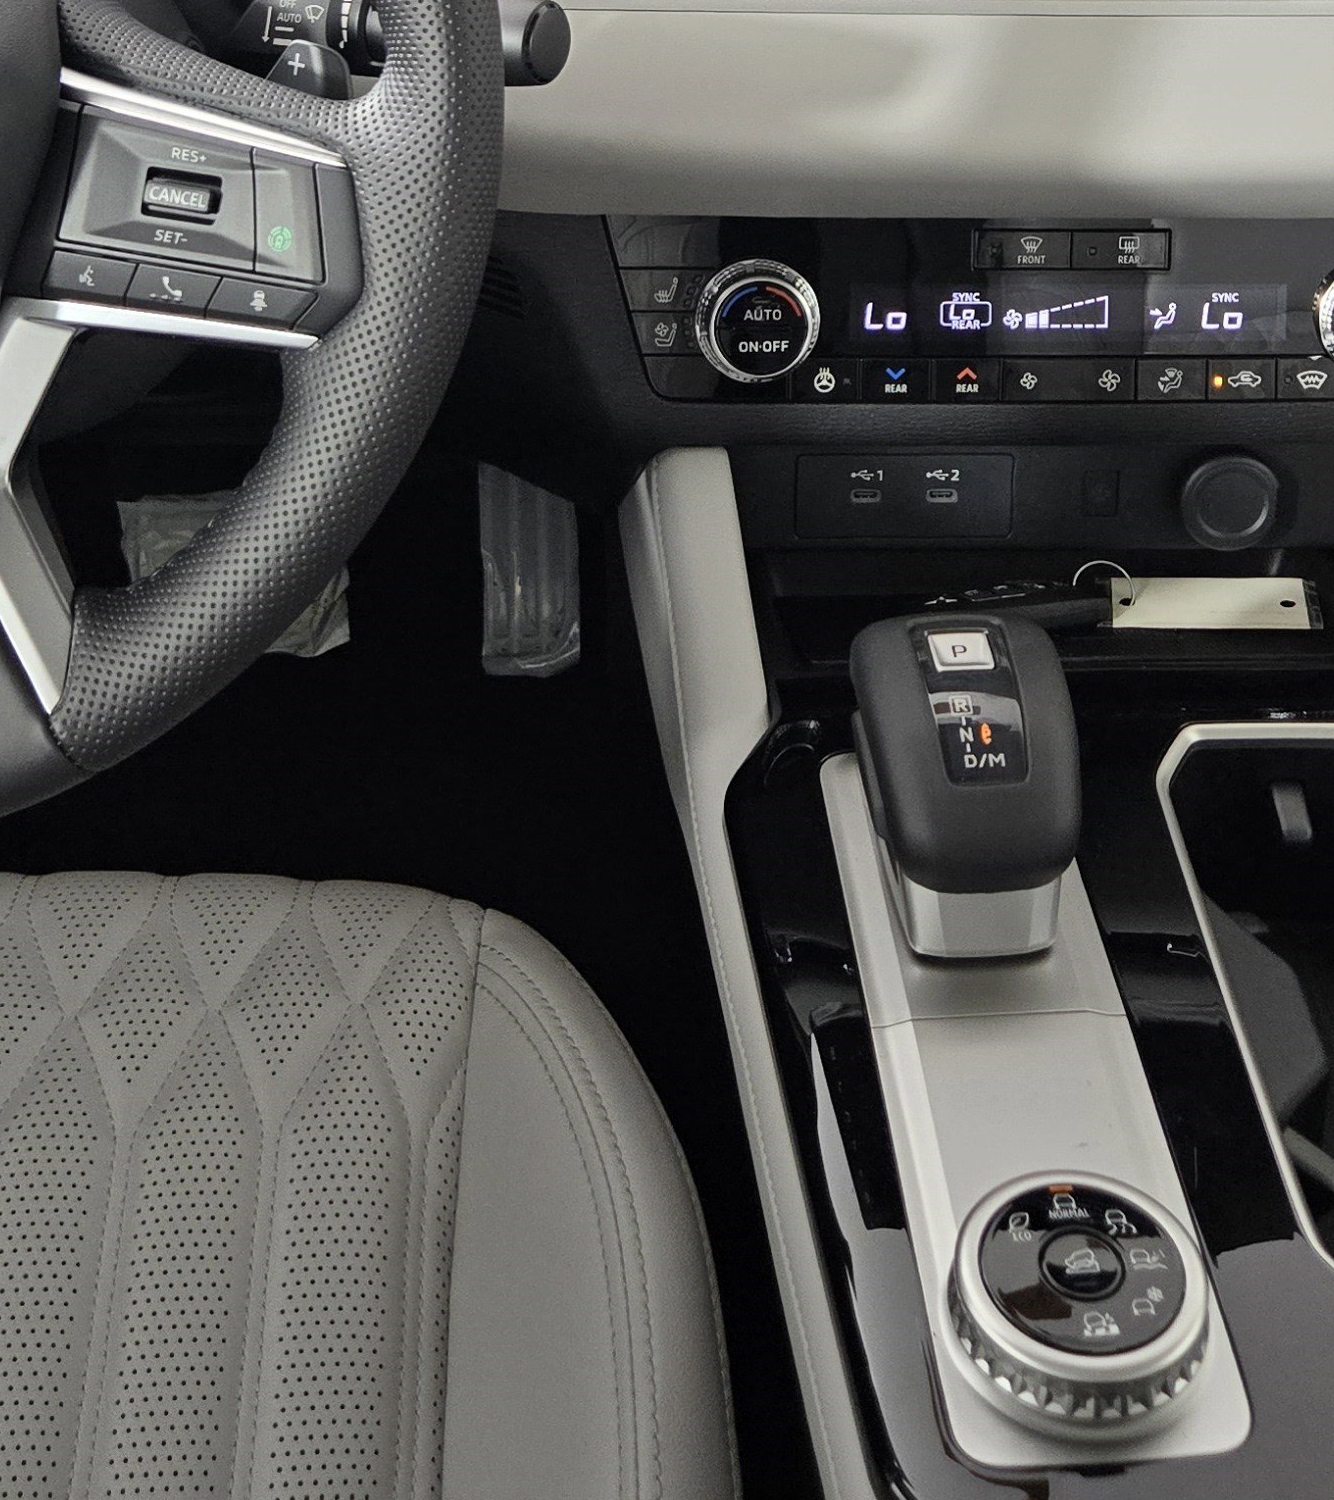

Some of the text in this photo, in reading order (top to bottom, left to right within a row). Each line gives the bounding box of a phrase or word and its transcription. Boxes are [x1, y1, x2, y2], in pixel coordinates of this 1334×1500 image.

[277, 12, 302, 23] AUTO
[171, 146, 207, 164] RES+
[148, 184, 207, 210] CANCEL
[1017, 255, 1046, 265] FRONT
[1118, 255, 1140, 265] REAR
[952, 292, 980, 301] SYNC
[1212, 292, 1239, 303] SYNC
[744, 309, 782, 321] AUTO
[864, 302, 907, 330] Lo
[1201, 302, 1243, 330] Lo
[951, 320, 981, 330] REAR
[885, 384, 907, 393] REAR
[956, 384, 979, 393] REAR
[950, 470, 960, 480] 2
[951, 644, 967, 657] P
[954, 699, 967, 712] R
[959, 727, 974, 742] N
[964, 753, 1006, 768] D/M
[1048, 1207, 1090, 1220] NORMAL
